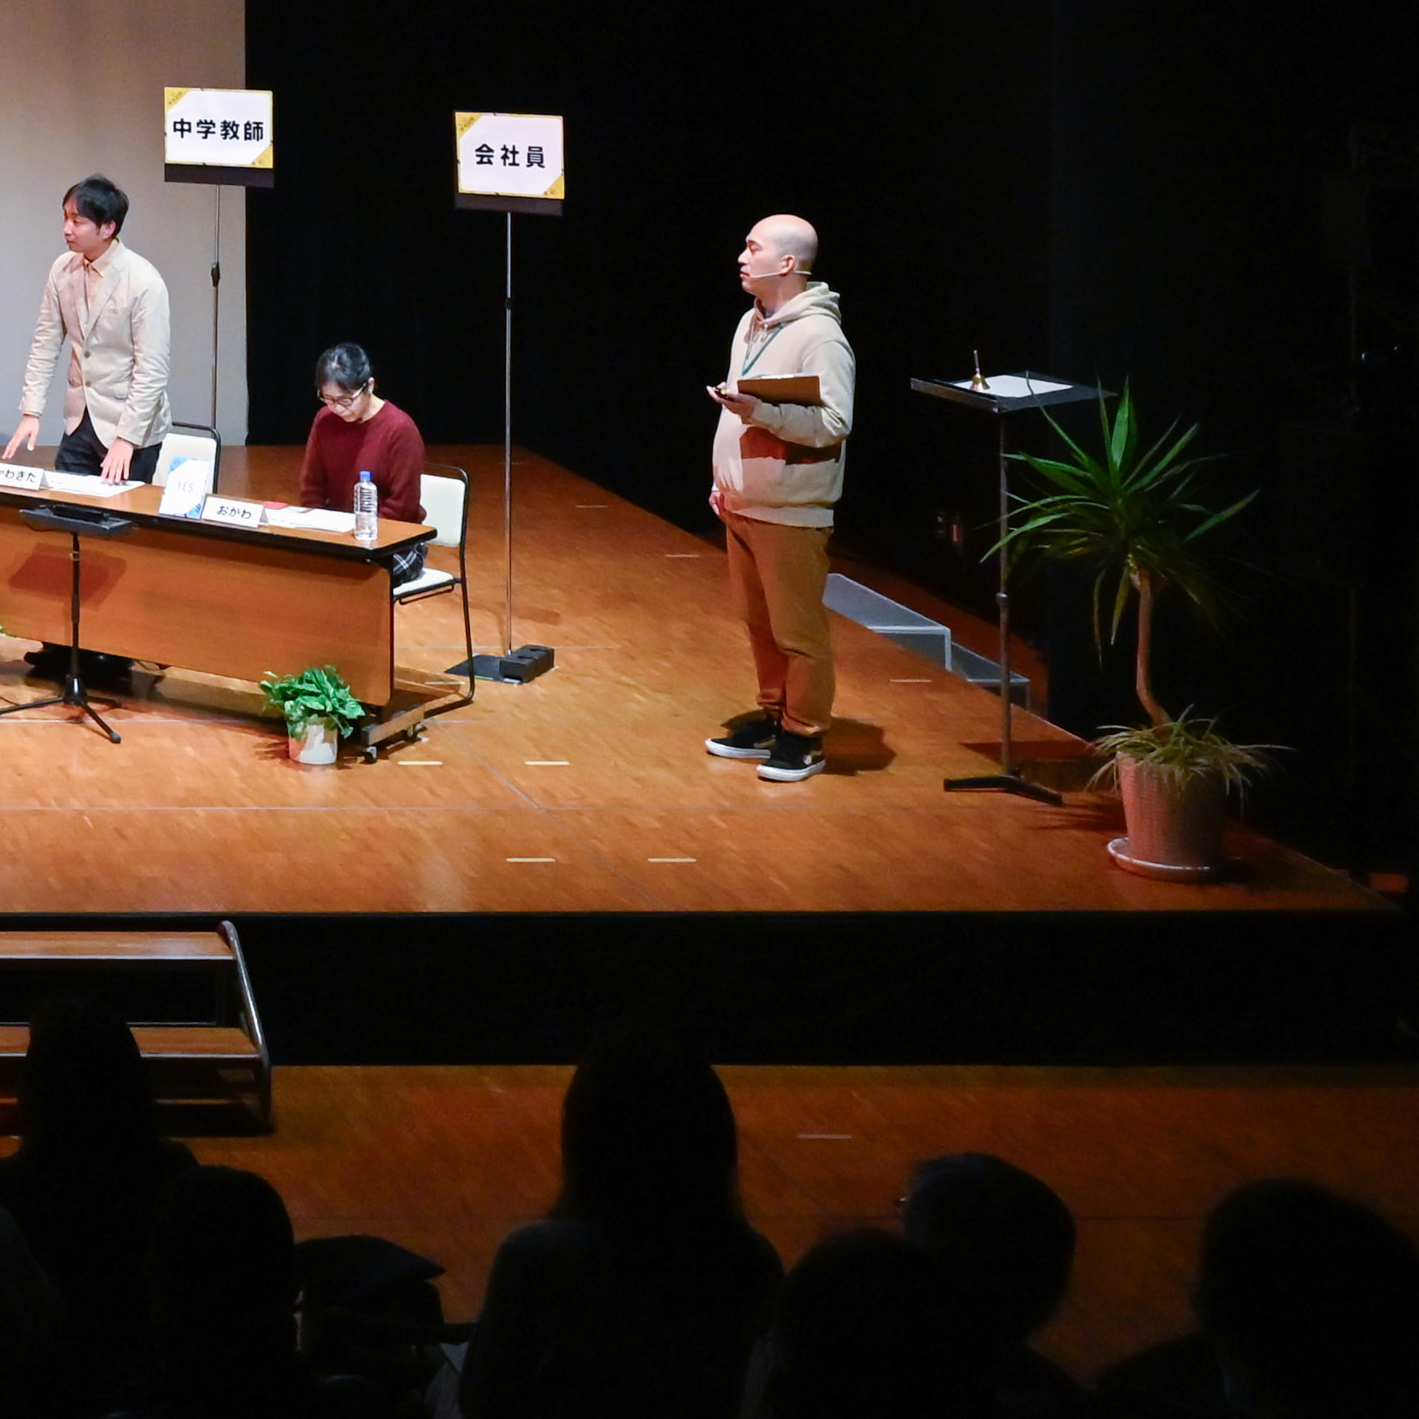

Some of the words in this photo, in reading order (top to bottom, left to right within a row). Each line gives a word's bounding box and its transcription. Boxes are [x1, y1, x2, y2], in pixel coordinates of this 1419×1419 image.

[172, 118, 264, 142] 中学教師
[474, 143, 546, 169] 会社員
[177, 481, 194, 493] YES
[216, 504, 253, 520] おがわ
